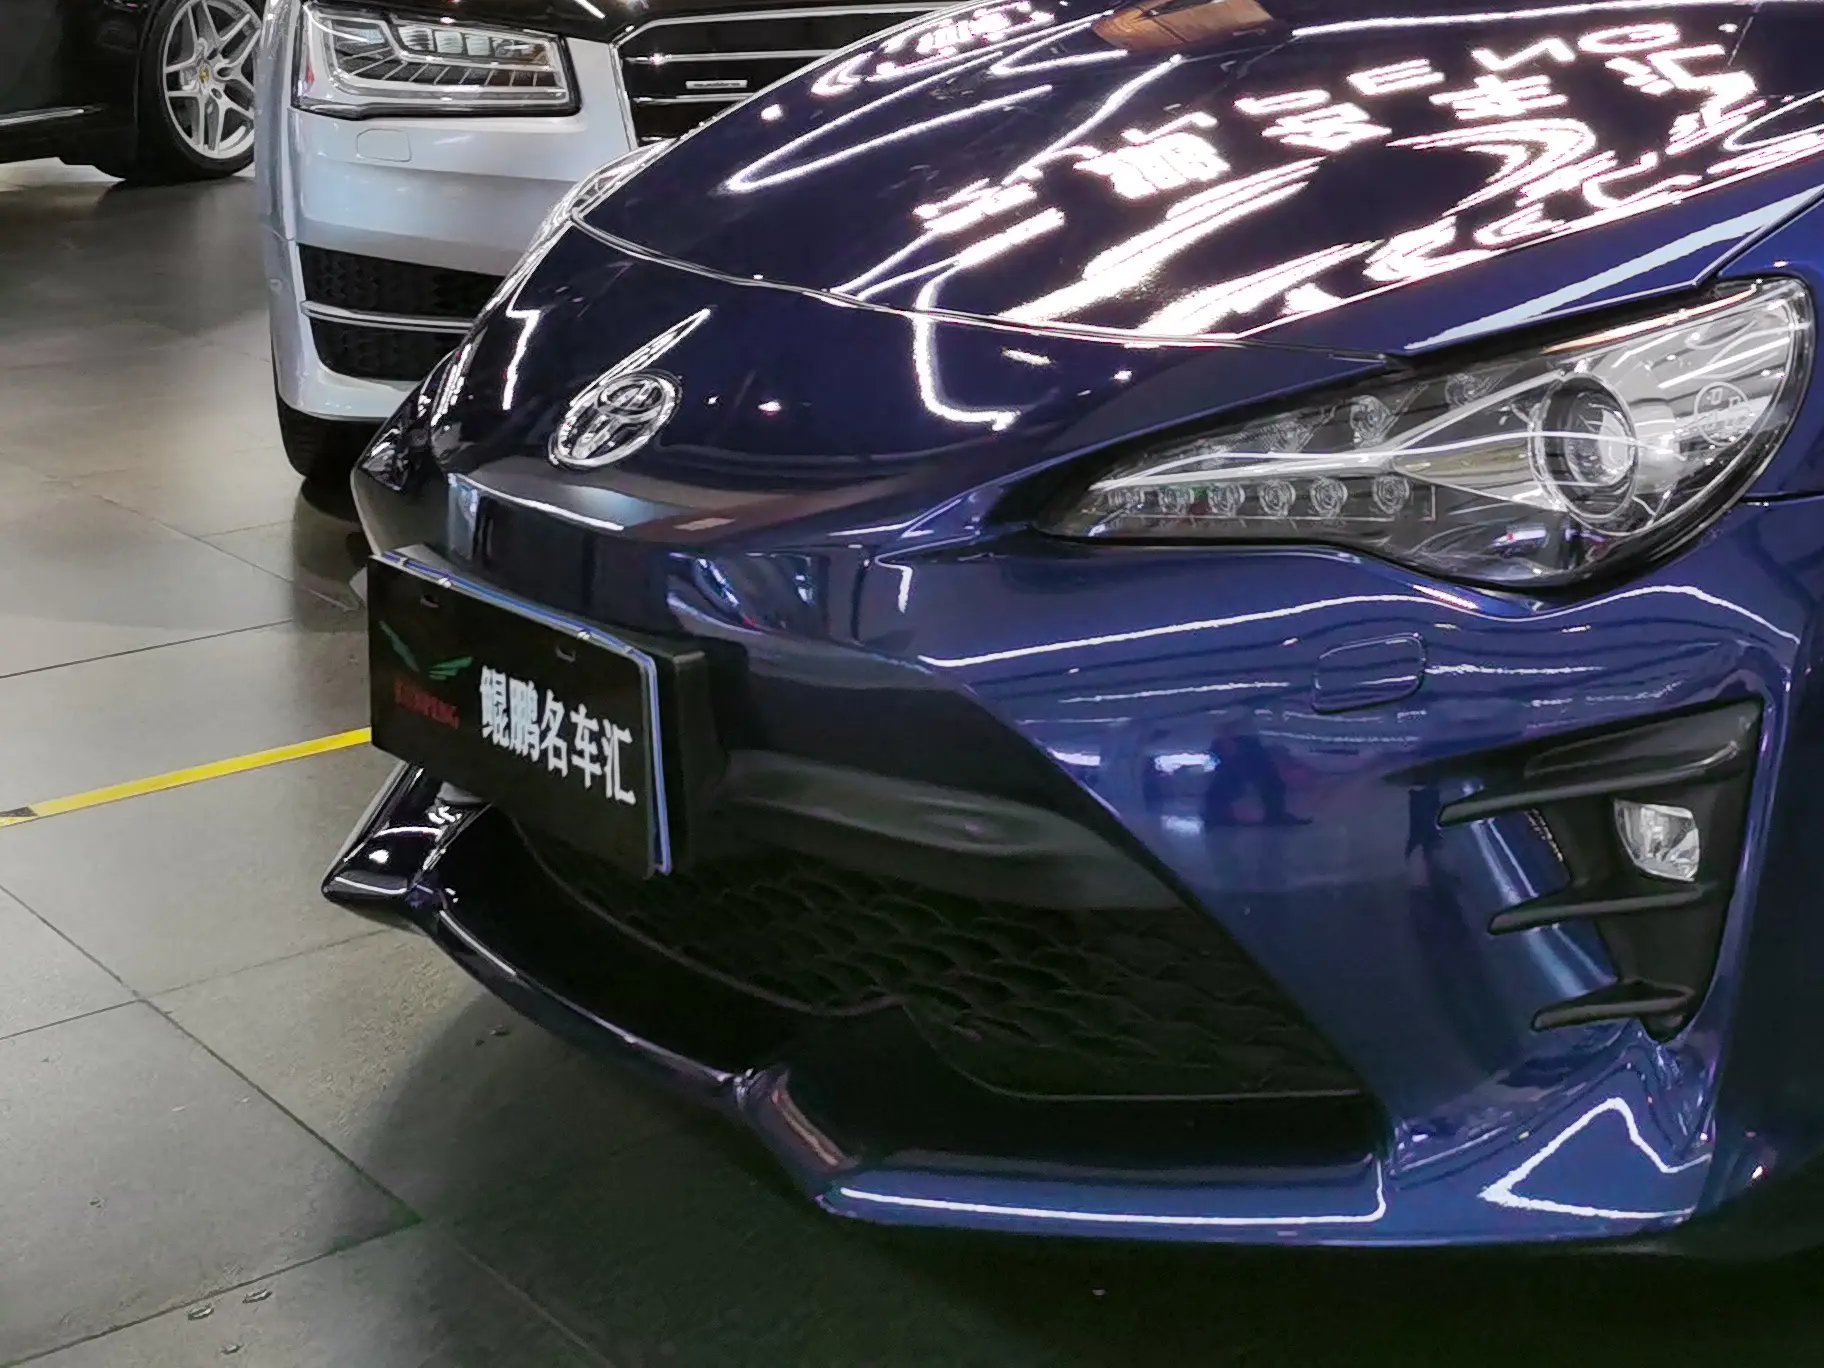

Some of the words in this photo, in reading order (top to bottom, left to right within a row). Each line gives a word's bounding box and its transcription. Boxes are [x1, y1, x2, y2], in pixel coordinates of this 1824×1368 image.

[479, 665, 637, 806] 鲲鹏名车汇
